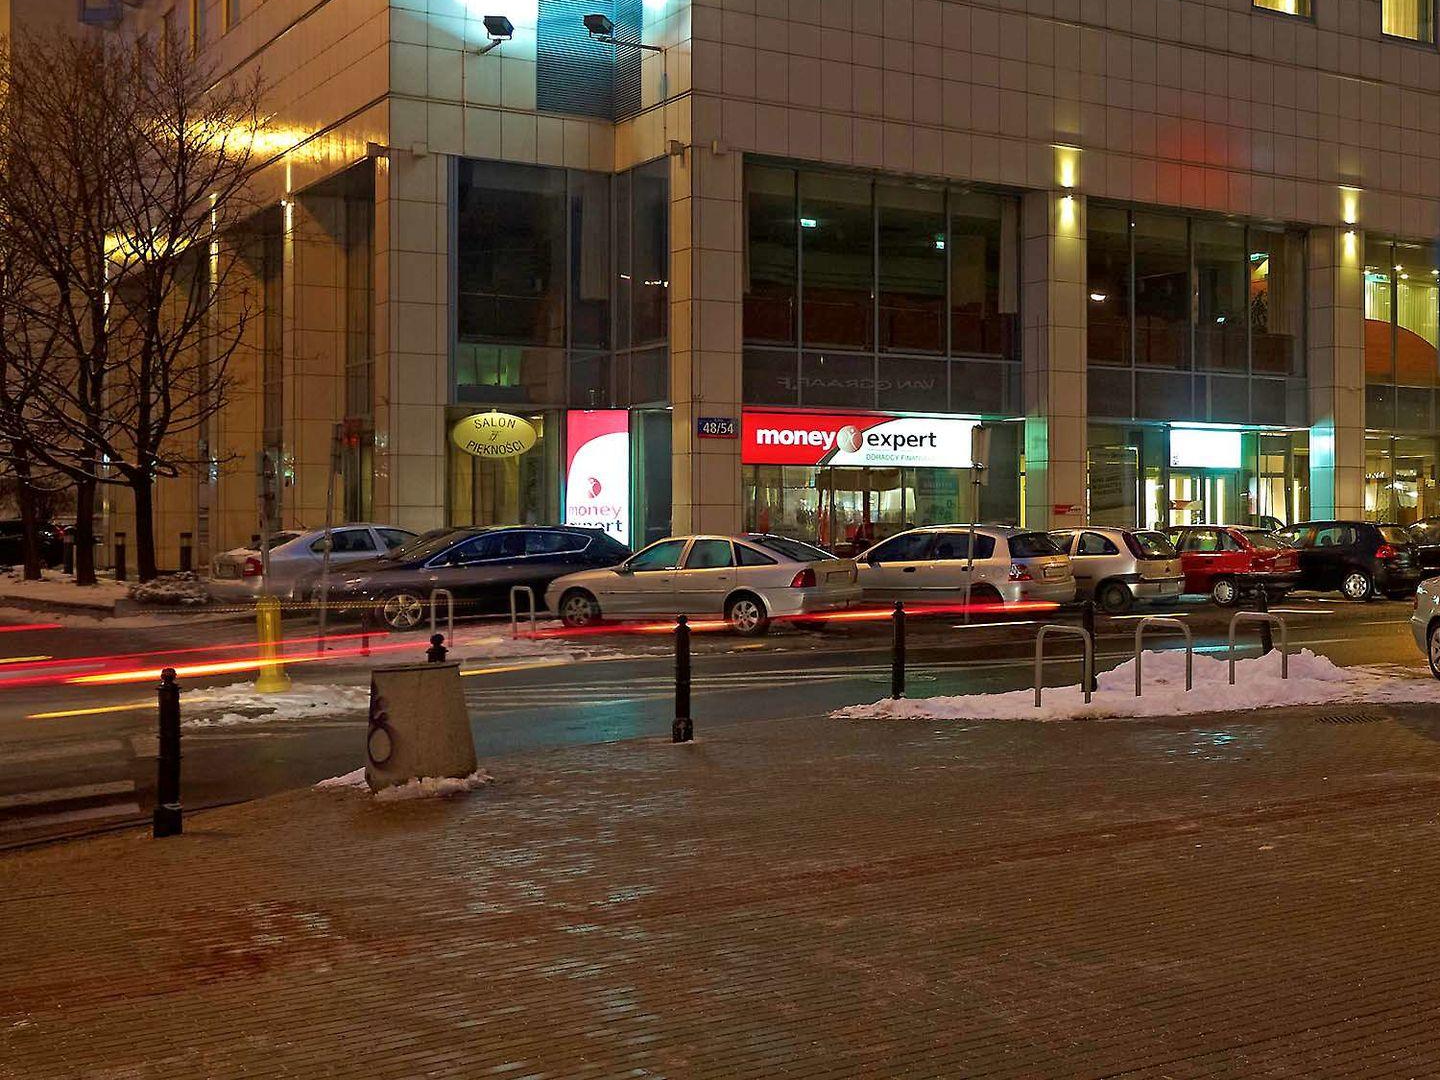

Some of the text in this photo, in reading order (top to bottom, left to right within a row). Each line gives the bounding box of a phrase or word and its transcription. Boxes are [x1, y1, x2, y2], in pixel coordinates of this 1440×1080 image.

[474, 418, 516, 429] SALON
[702, 422, 734, 434] 48/54
[756, 428, 937, 451] money expert
[569, 505, 622, 520] money
